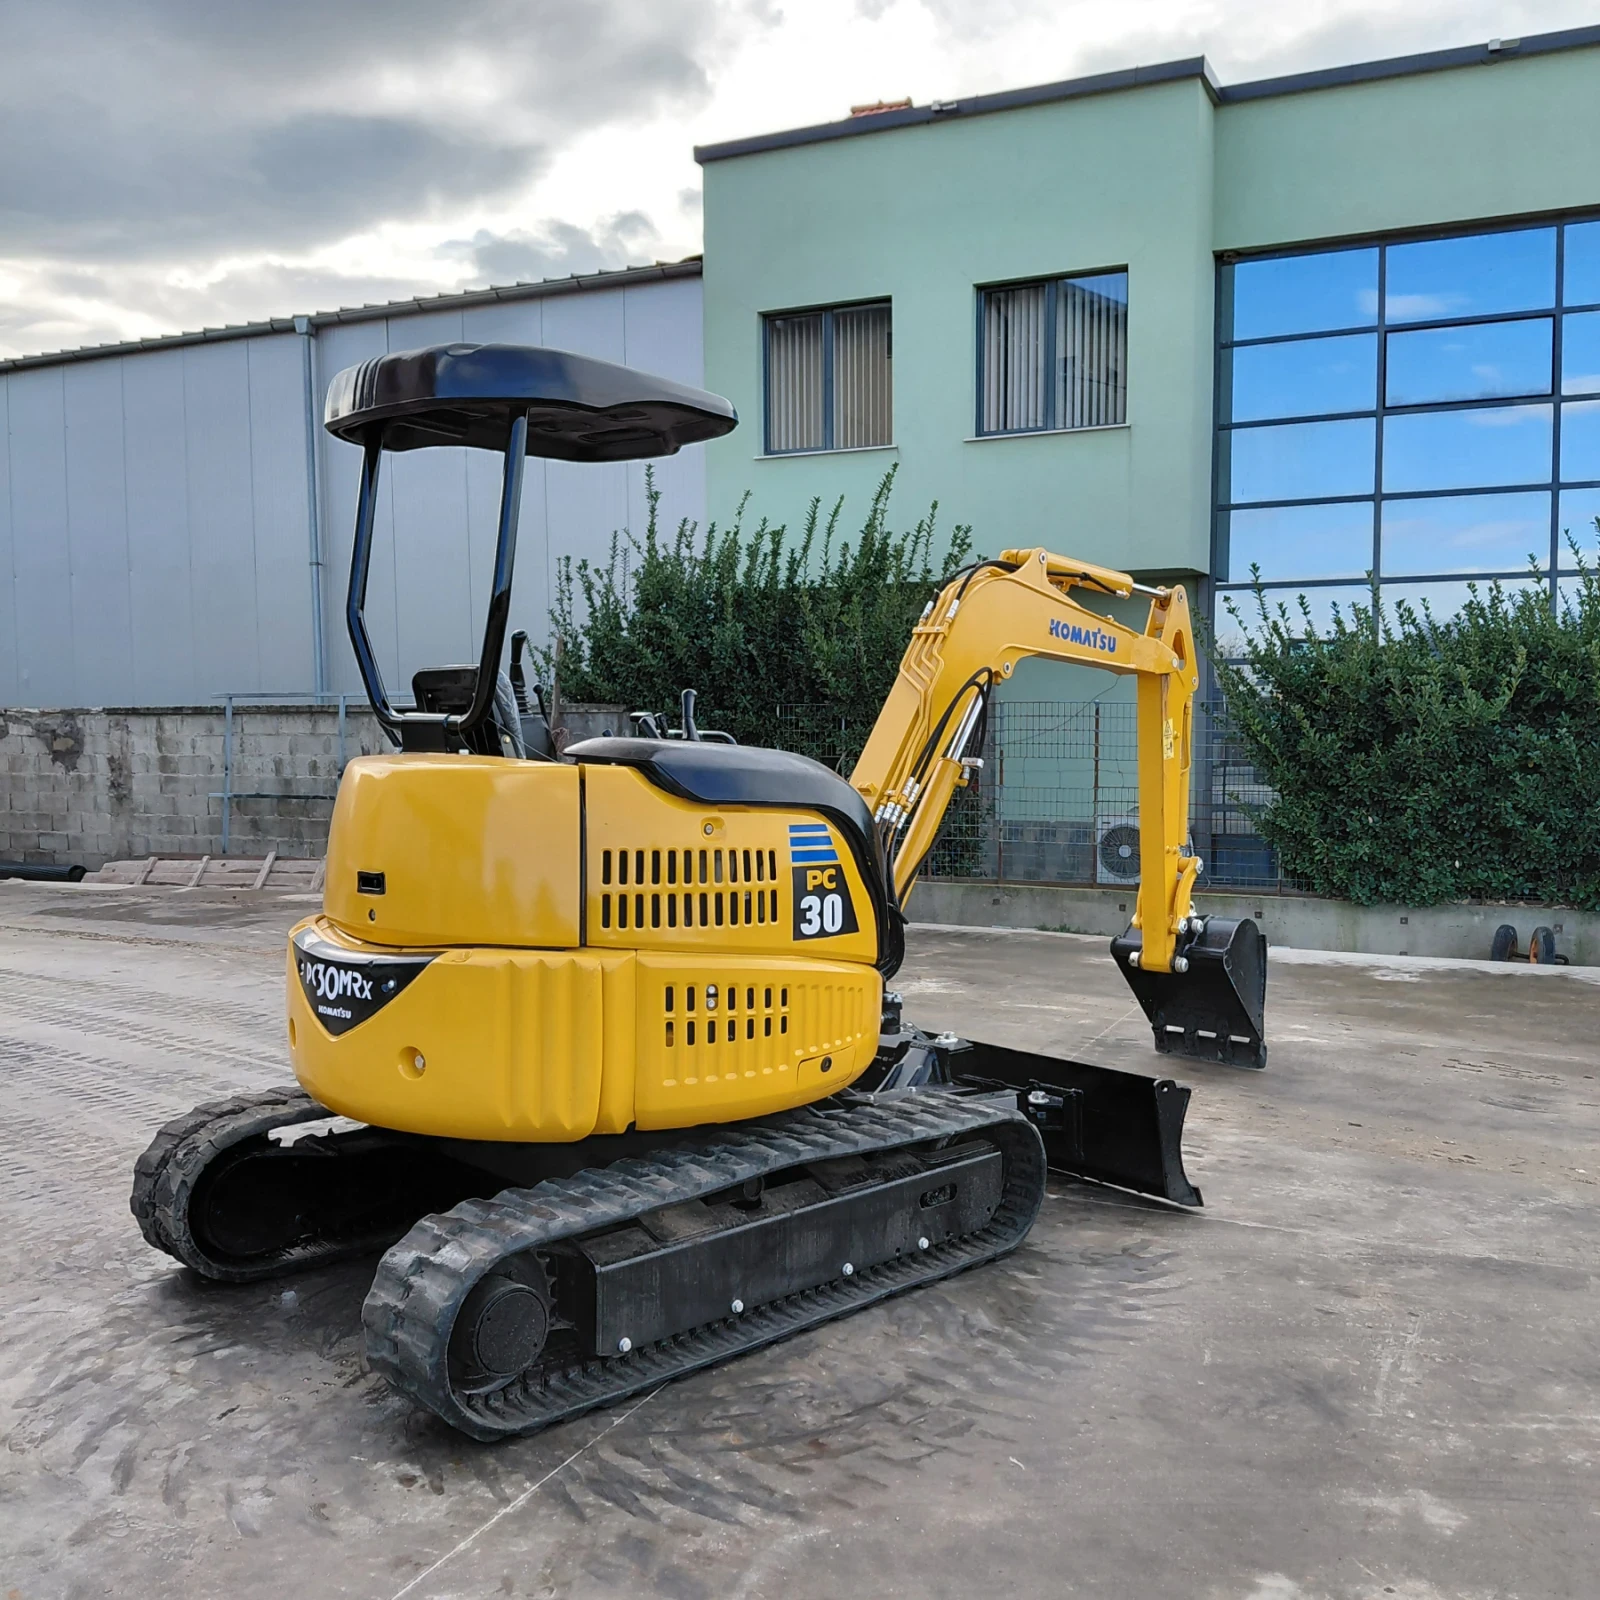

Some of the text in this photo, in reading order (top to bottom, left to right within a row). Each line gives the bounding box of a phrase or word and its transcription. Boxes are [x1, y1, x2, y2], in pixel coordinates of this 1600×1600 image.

[1049, 618, 1117, 653] KOMATSU
[806, 868, 837, 891] PC
[800, 893, 843, 935] 30
[318, 1004, 352, 1019] KOMATSU
